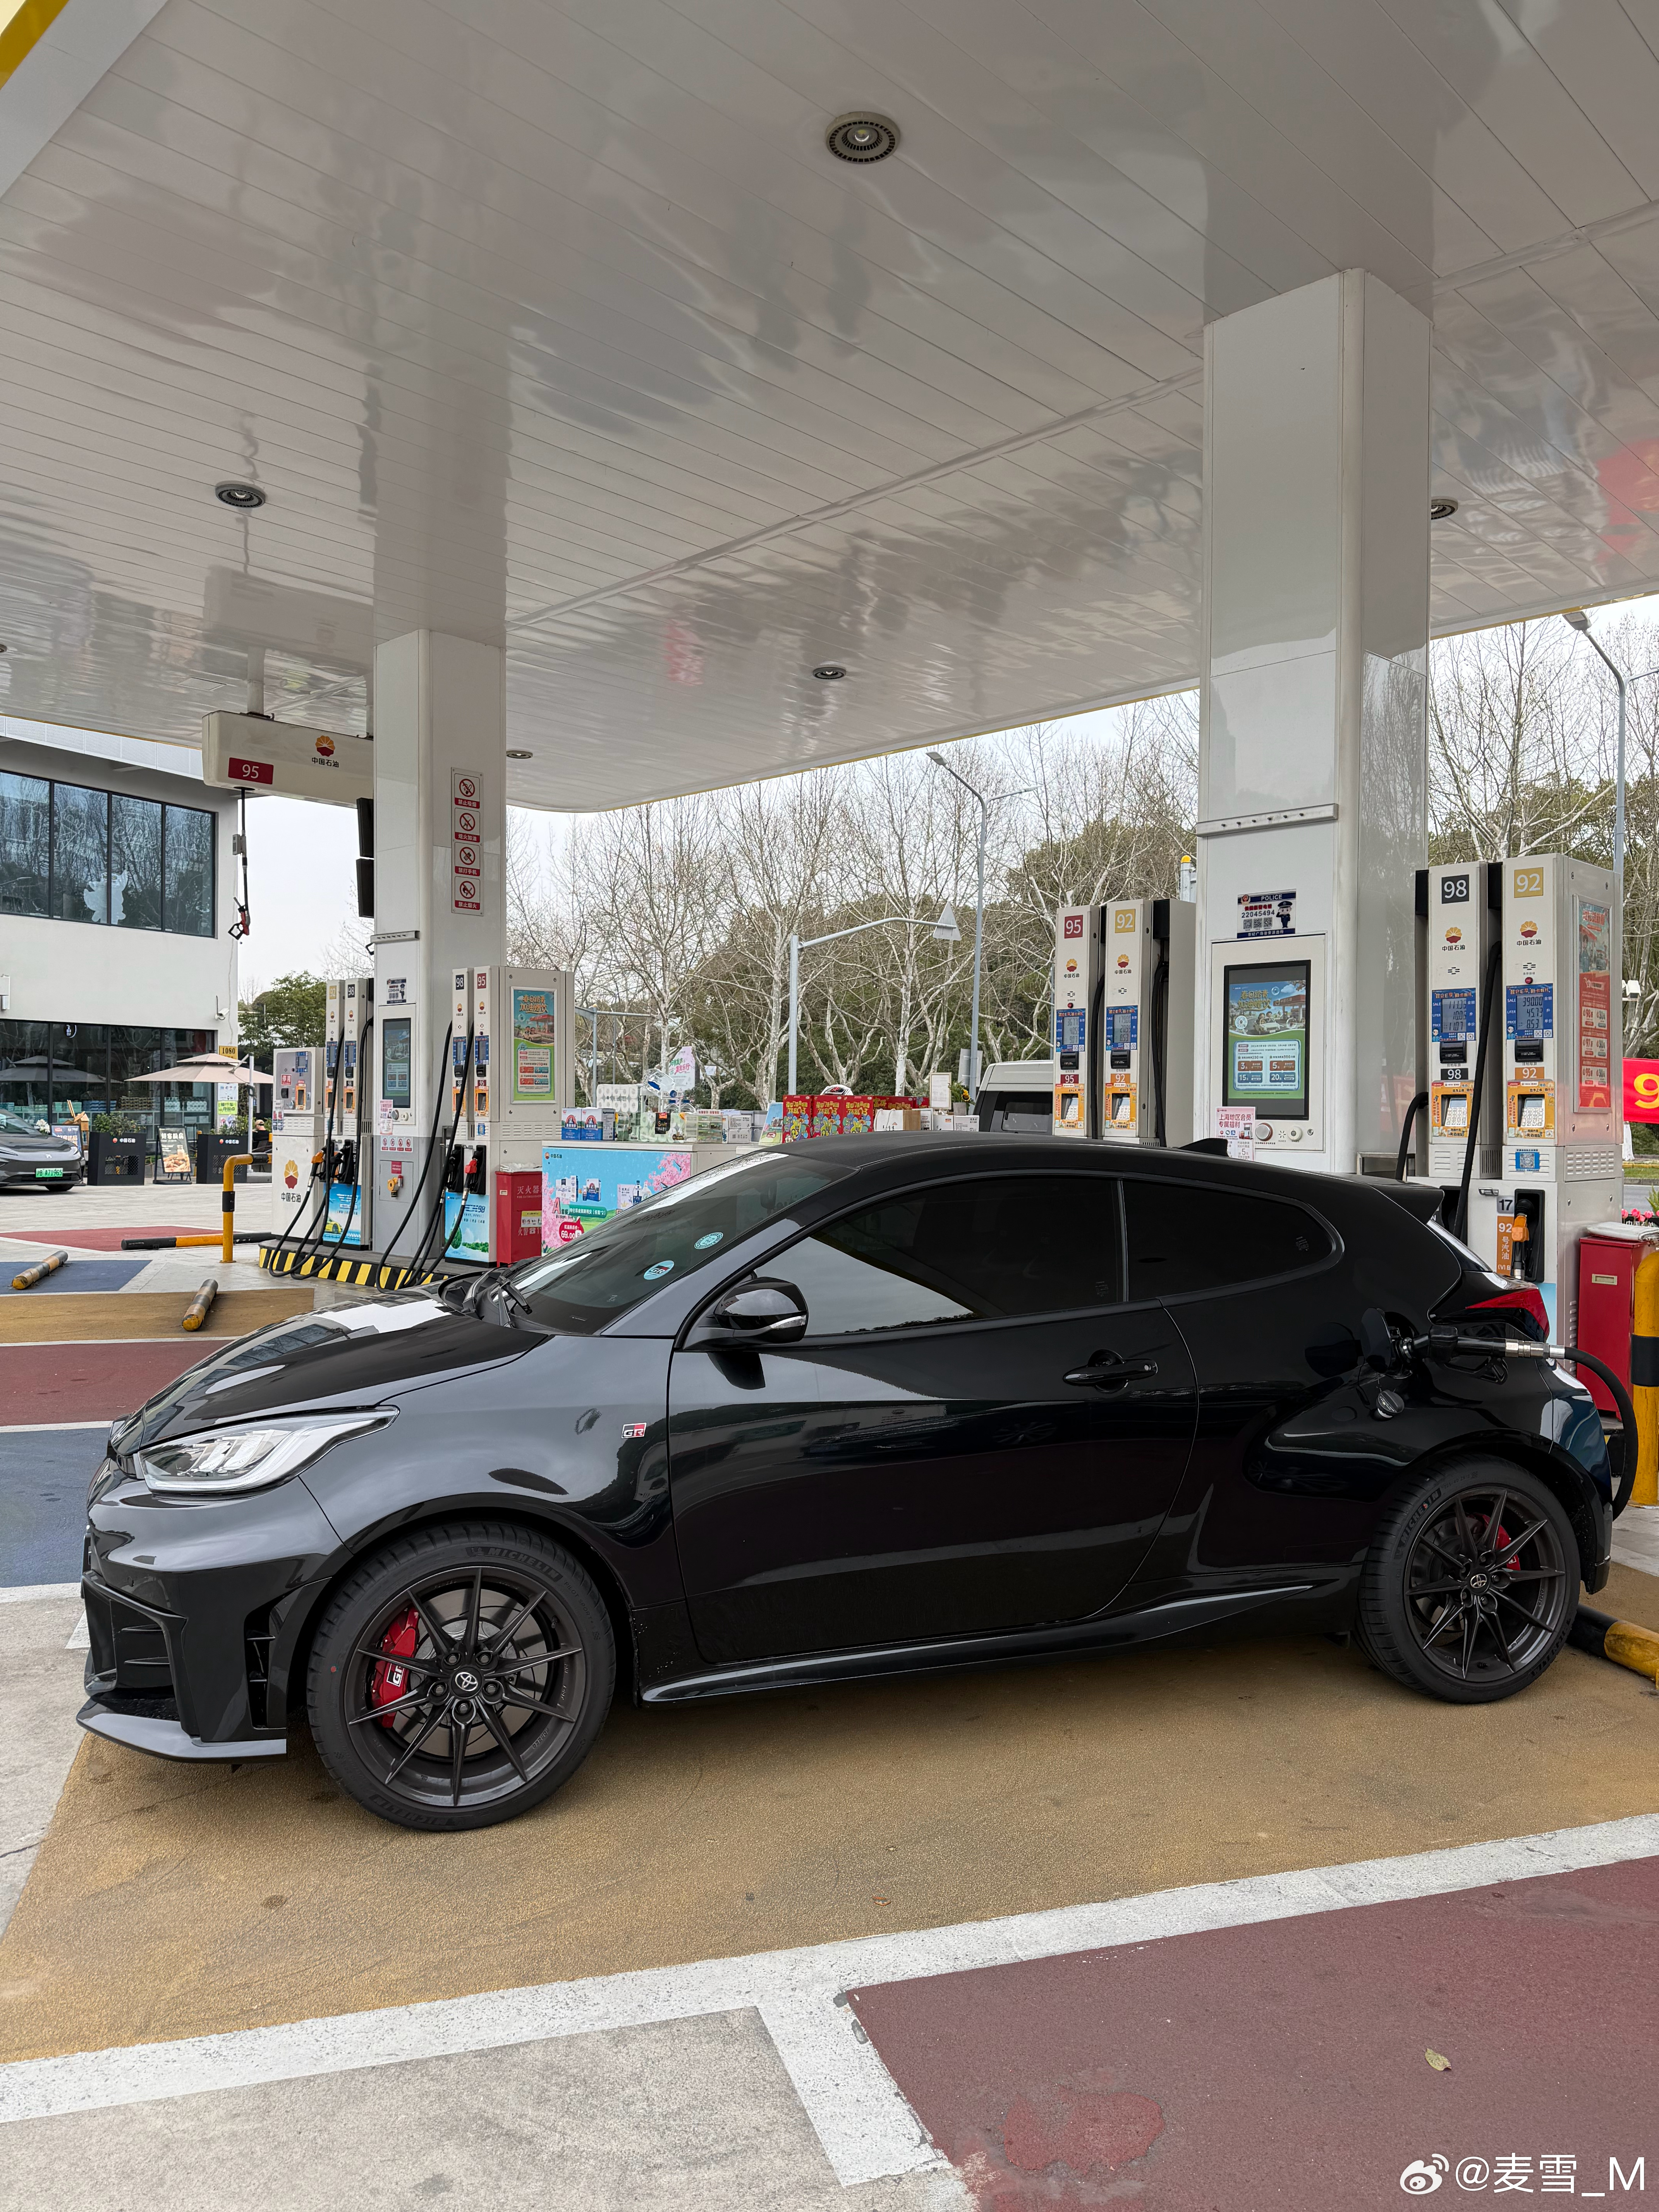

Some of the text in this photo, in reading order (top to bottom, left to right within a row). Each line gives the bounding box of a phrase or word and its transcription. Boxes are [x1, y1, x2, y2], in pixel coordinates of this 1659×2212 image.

[312, 757, 339, 768] 中国石油
[242, 764, 259, 778] 95
[458, 799, 477, 807] 禁止吸烟
[458, 833, 477, 842] 熄火加油
[1516, 873, 1541, 892] 92
[1444, 881, 1467, 898] 98
[459, 901, 477, 909] 禁止烟火
[1241, 909, 1275, 918] 22045494
[1116, 914, 1133, 928] 92
[1066, 920, 1081, 934] 95
[456, 977, 464, 988] 98
[478, 976, 486, 986] 95
[330, 988, 336, 997] 92
[348, 986, 354, 995] 98
[1065, 1075, 1074, 1083] 95
[1115, 1074, 1125, 1082] 92
[1448, 1069, 1462, 1079] 98
[1522, 1068, 1537, 1079] 92
[281, 1192, 301, 1203] 中国石油
[1499, 1199, 1513, 1211] 17
[1498, 1223, 1512, 1233] 92
[1501, 1237, 1510, 1260] 号汽油
[623, 1429, 644, 1437] GR
[1400, 1490, 1439, 1544] MICHEIN
[488, 1547, 560, 1579] MICHELIN
[564, 1581, 579, 1598] PILOT
[579, 1600, 592, 1621] SPORT
[369, 1793, 449, 1827] MICHELIN
